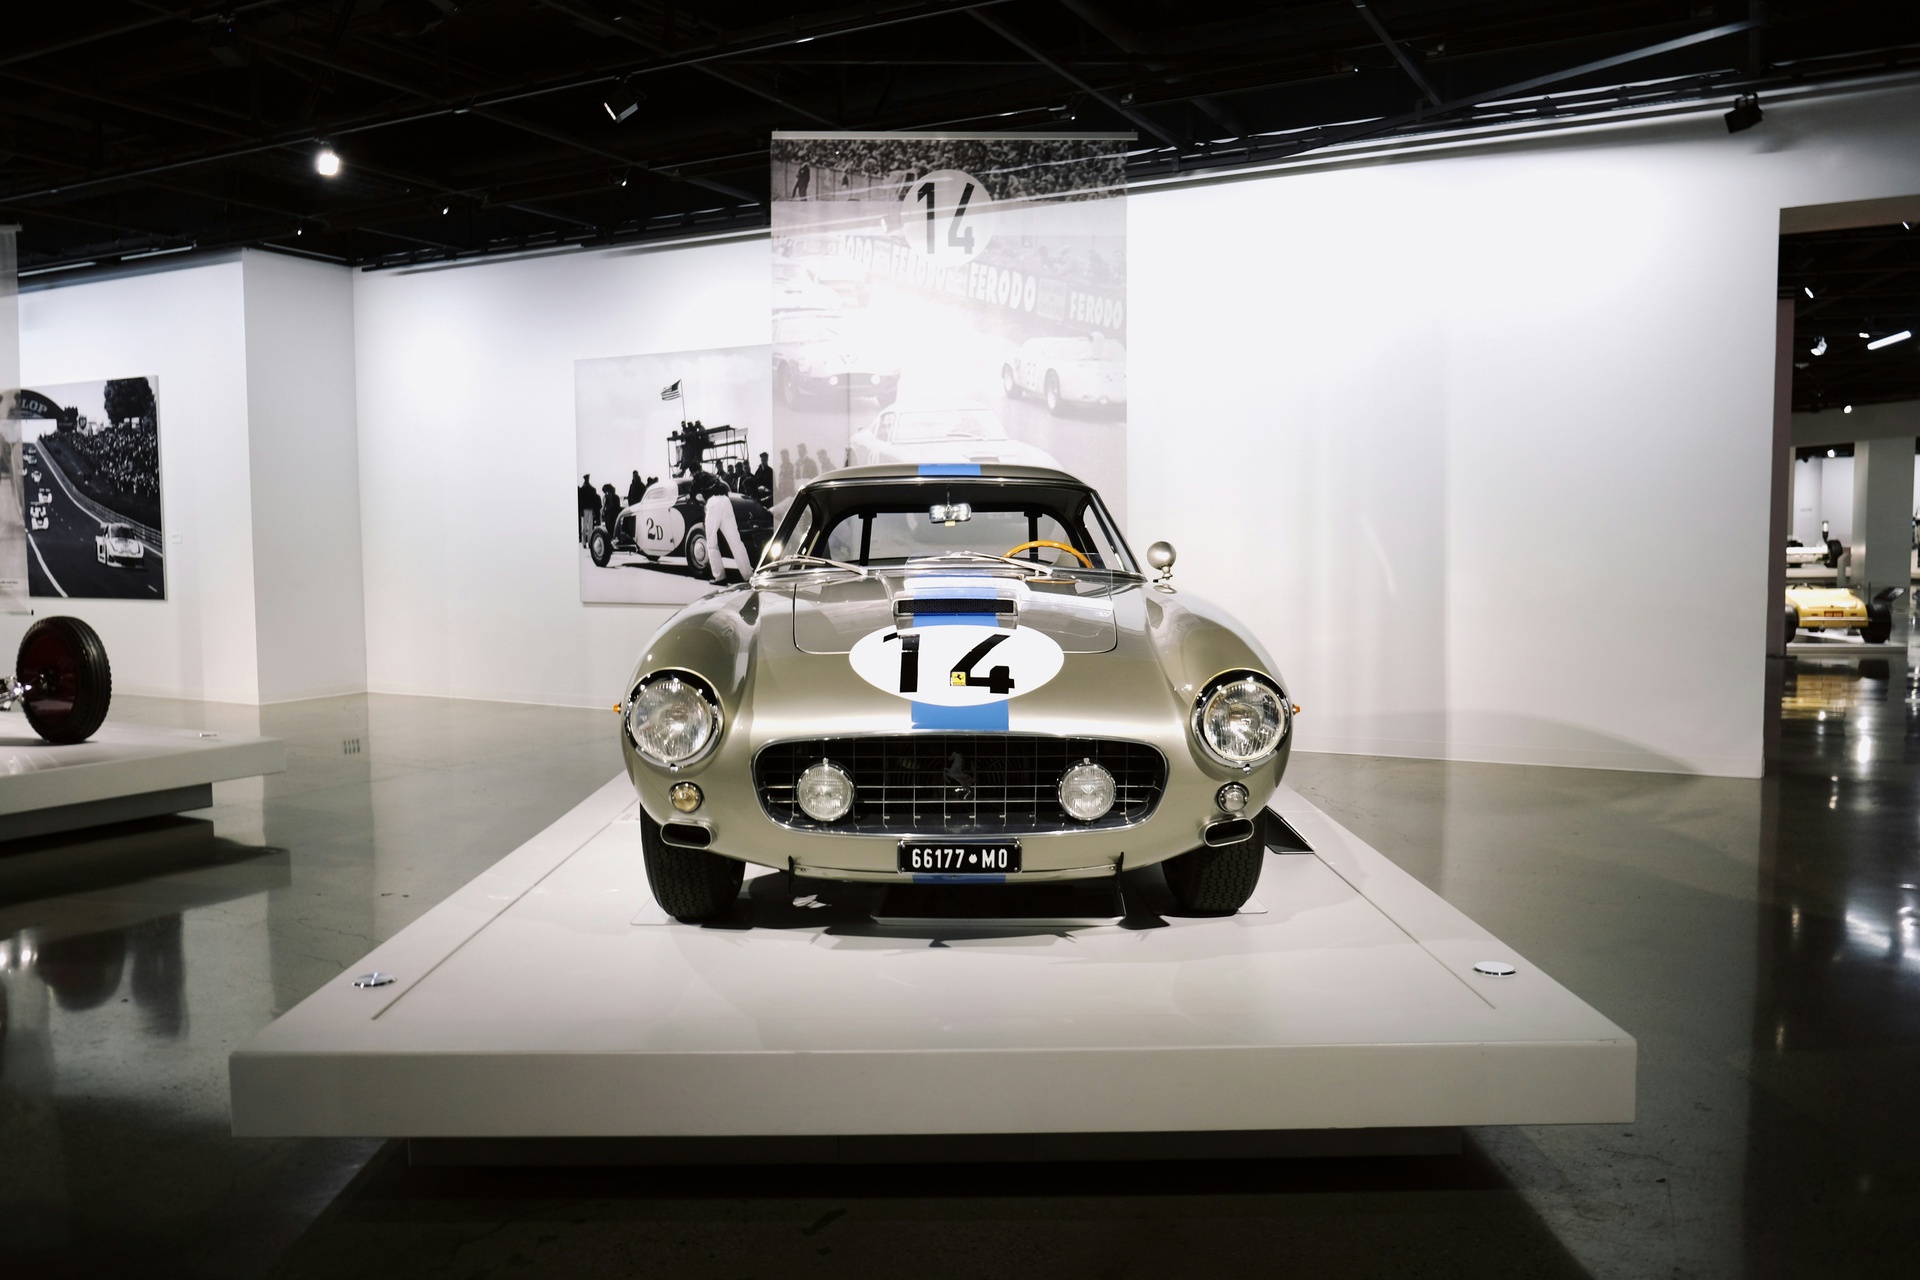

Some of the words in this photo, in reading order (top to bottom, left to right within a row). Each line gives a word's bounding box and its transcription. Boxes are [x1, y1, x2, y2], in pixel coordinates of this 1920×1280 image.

[917, 182, 975, 255] 14
[968, 261, 1036, 312] FERODO
[1069, 291, 1123, 330] FERODO
[20, 398, 48, 413] LOP
[646, 517, 664, 541] 2D
[883, 632, 1015, 695] 14
[912, 848, 966, 869] 66177
